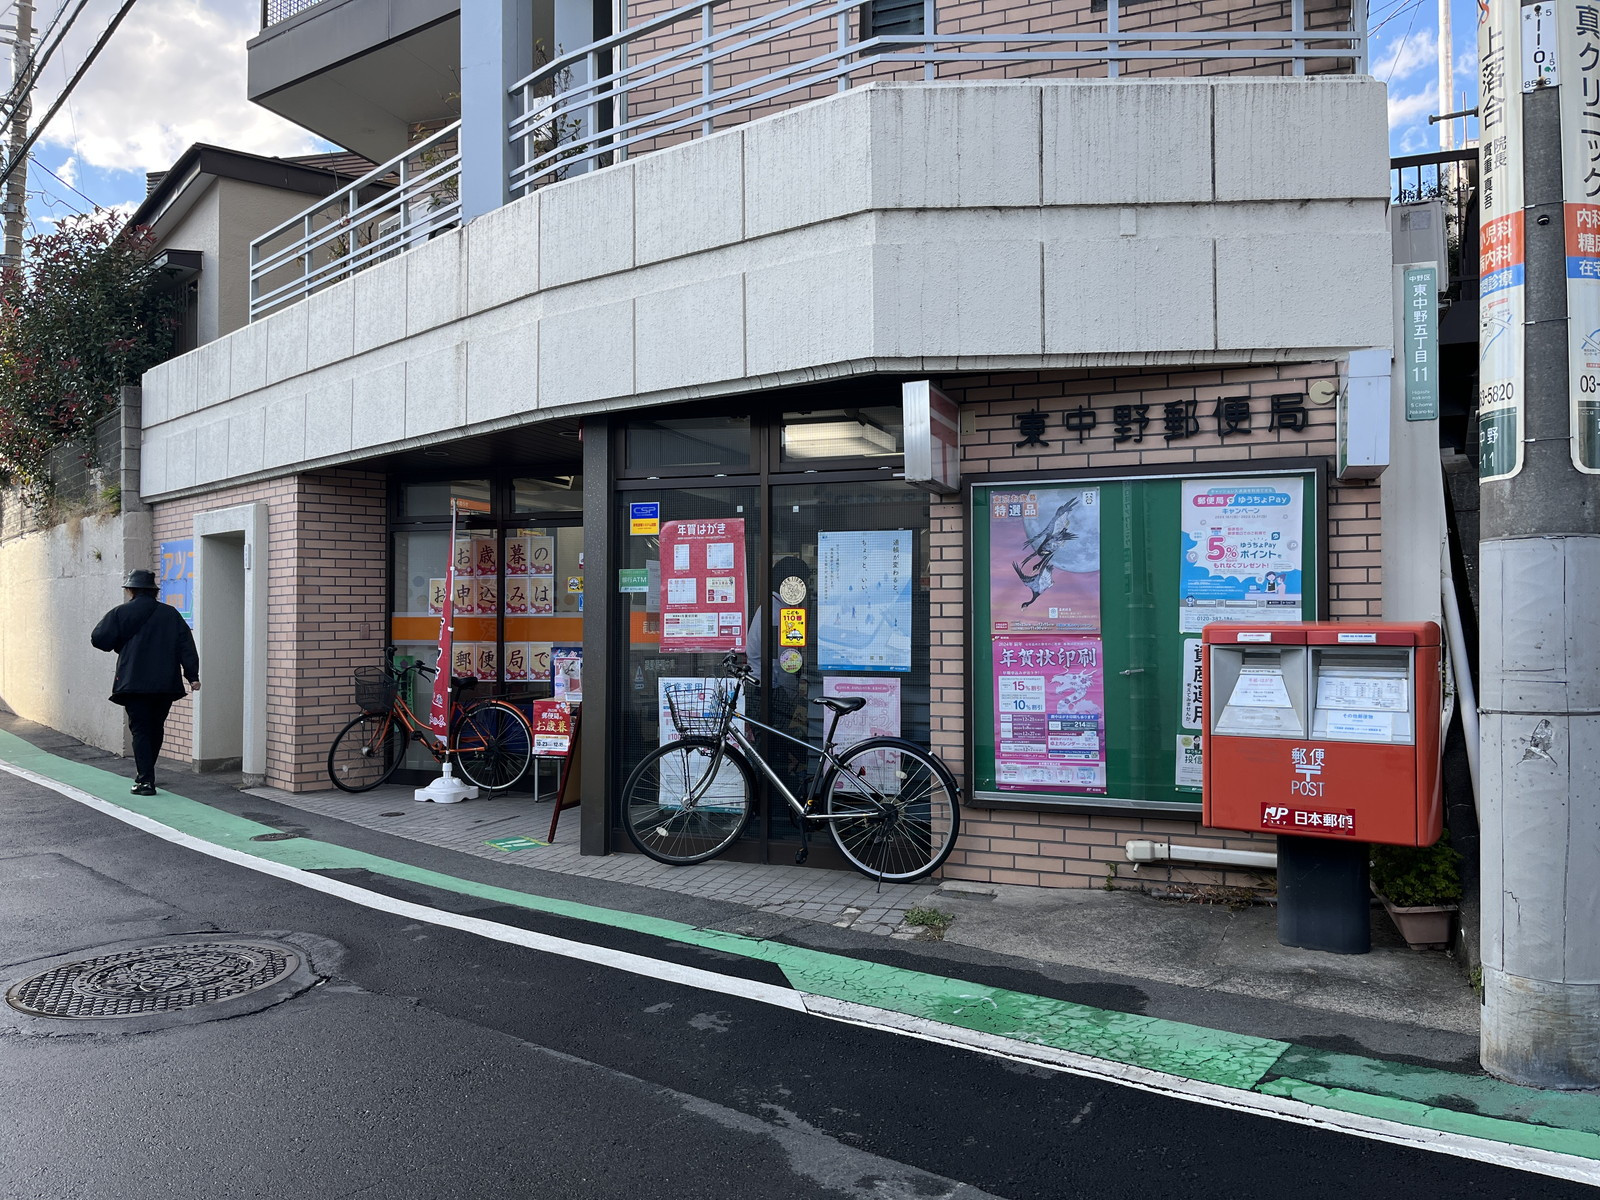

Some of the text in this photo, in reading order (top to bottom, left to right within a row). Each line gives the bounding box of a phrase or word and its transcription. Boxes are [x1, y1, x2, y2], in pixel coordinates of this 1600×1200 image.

[1481, 26, 1505, 131] 上落合
[1408, 274, 1431, 282] 中野区
[1015, 392, 1309, 449] 東中野郵便局
[633, 506, 657, 514] CSP
[994, 504, 1037, 517] 特選品
[677, 522, 726, 536] 年賀はがき
[457, 542, 549, 566] お歳暮の
[434, 584, 549, 607] お申込みは
[456, 649, 549, 672] 郵便局で
[999, 647, 1097, 668] 年賀状印刷
[1291, 747, 1325, 766] 郵便
[1291, 780, 1325, 797] POST
[1295, 811, 1354, 829] 日本郵便
